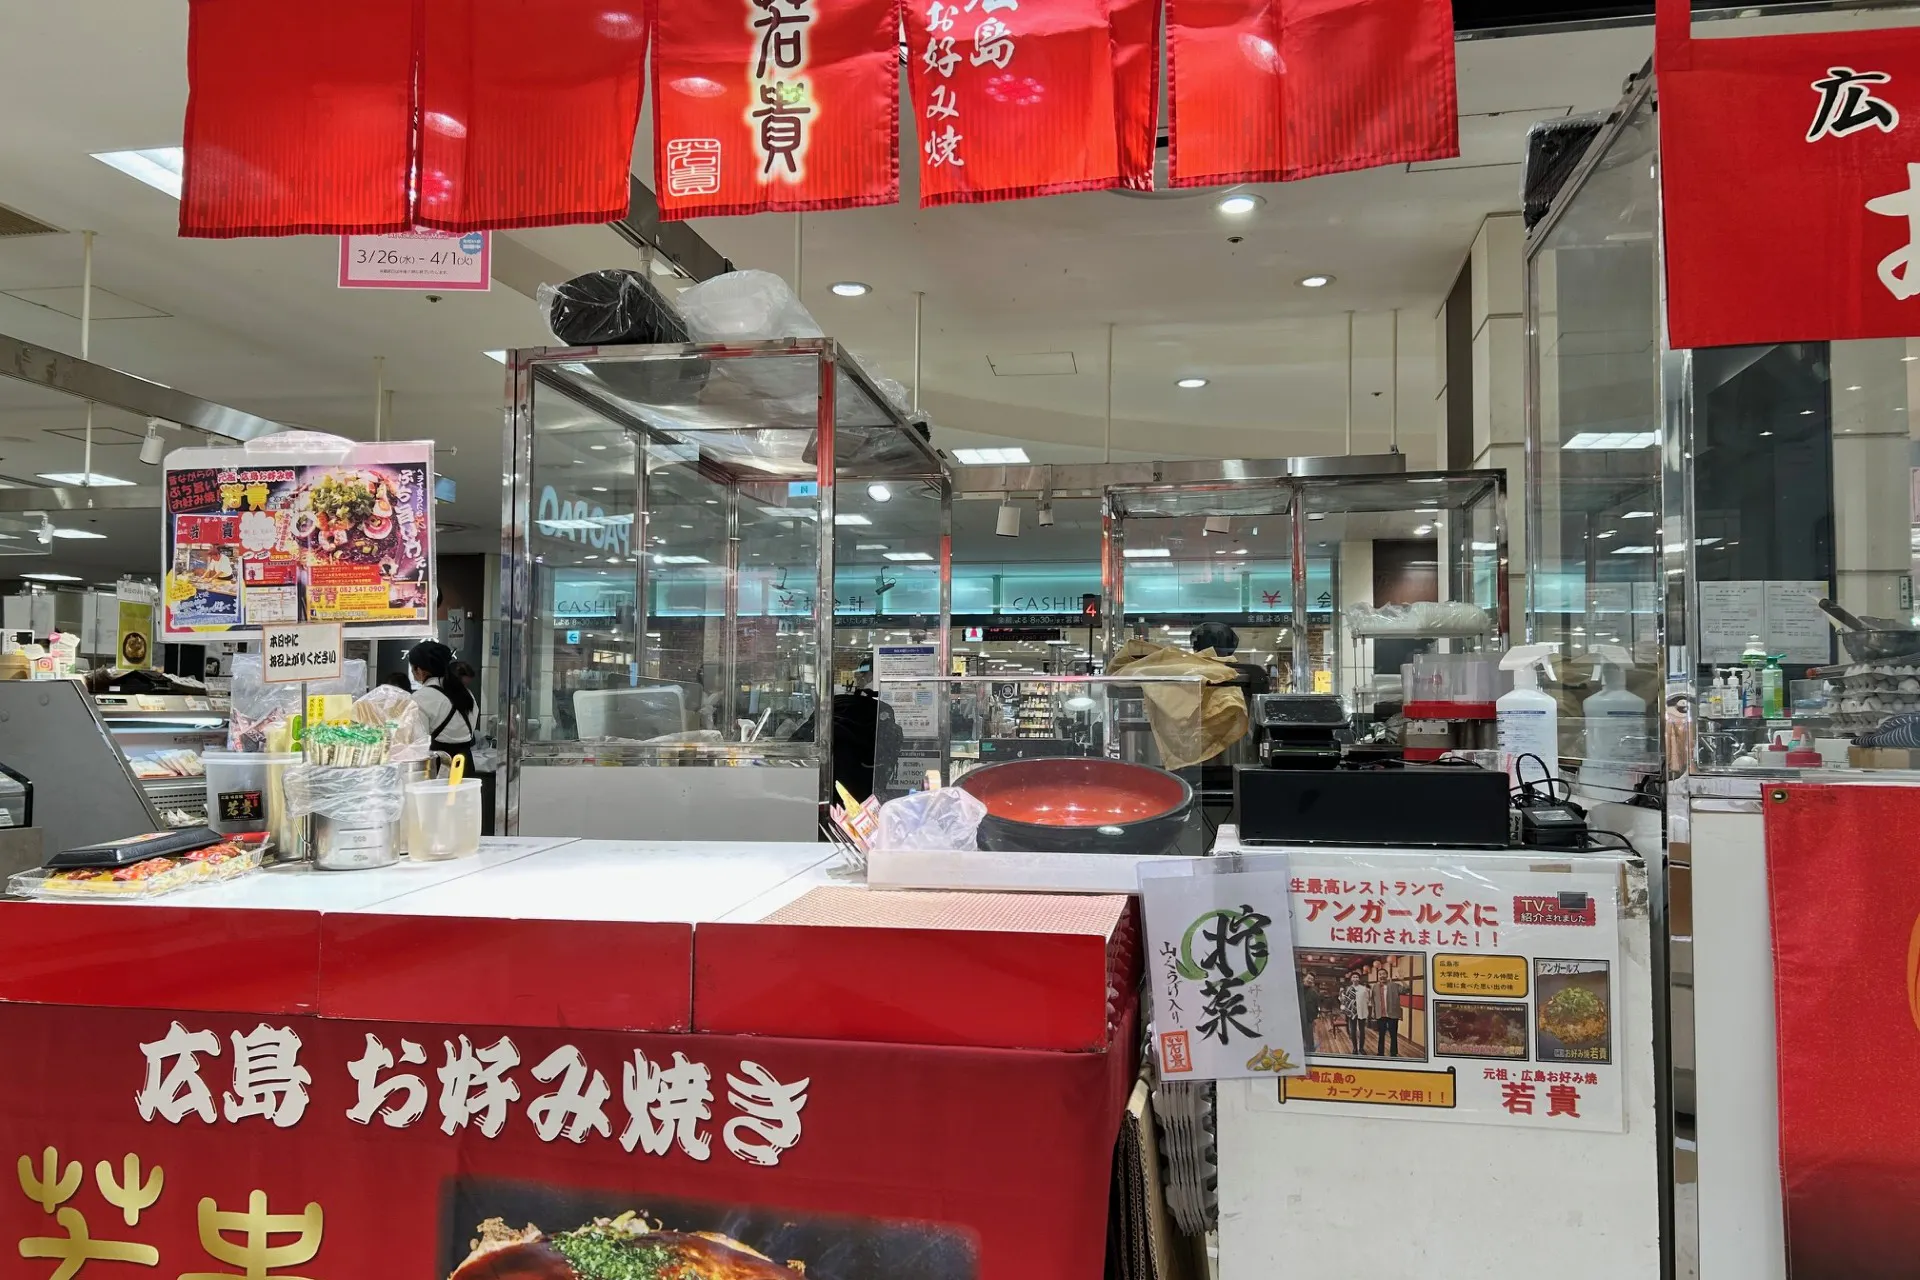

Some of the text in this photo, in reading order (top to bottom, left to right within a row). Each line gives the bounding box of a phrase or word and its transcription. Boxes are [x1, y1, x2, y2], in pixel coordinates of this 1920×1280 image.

[966, 0, 1019, 68] 島
[922, 1, 966, 168] お好み焼
[1806, 66, 1900, 143] 広
[357, 249, 415, 265] 3/26(水)
[430, 251, 473, 266] 4/1(火)
[1013, 597, 1083, 611] CASHIE
[1086, 602, 1097, 617] 4
[269, 634, 299, 648] 本日中に
[269, 650, 337, 668] お召上がりください
[1286, 878, 1444, 897] 生最高レストランで
[1304, 898, 1500, 927] アンガールズに
[1520, 912, 1586, 924] 紹介されました
[1329, 927, 1499, 948] に紹介されました！！
[1540, 962, 1580, 974] アンガールズ
[1483, 1067, 1598, 1086] 元祖・広島お好み焼
[134, 1020, 811, 1168] 広島 お好み焼き
[1326, 1086, 1447, 1104] カープソース使用！！
[1501, 1081, 1582, 1119] 若貴
